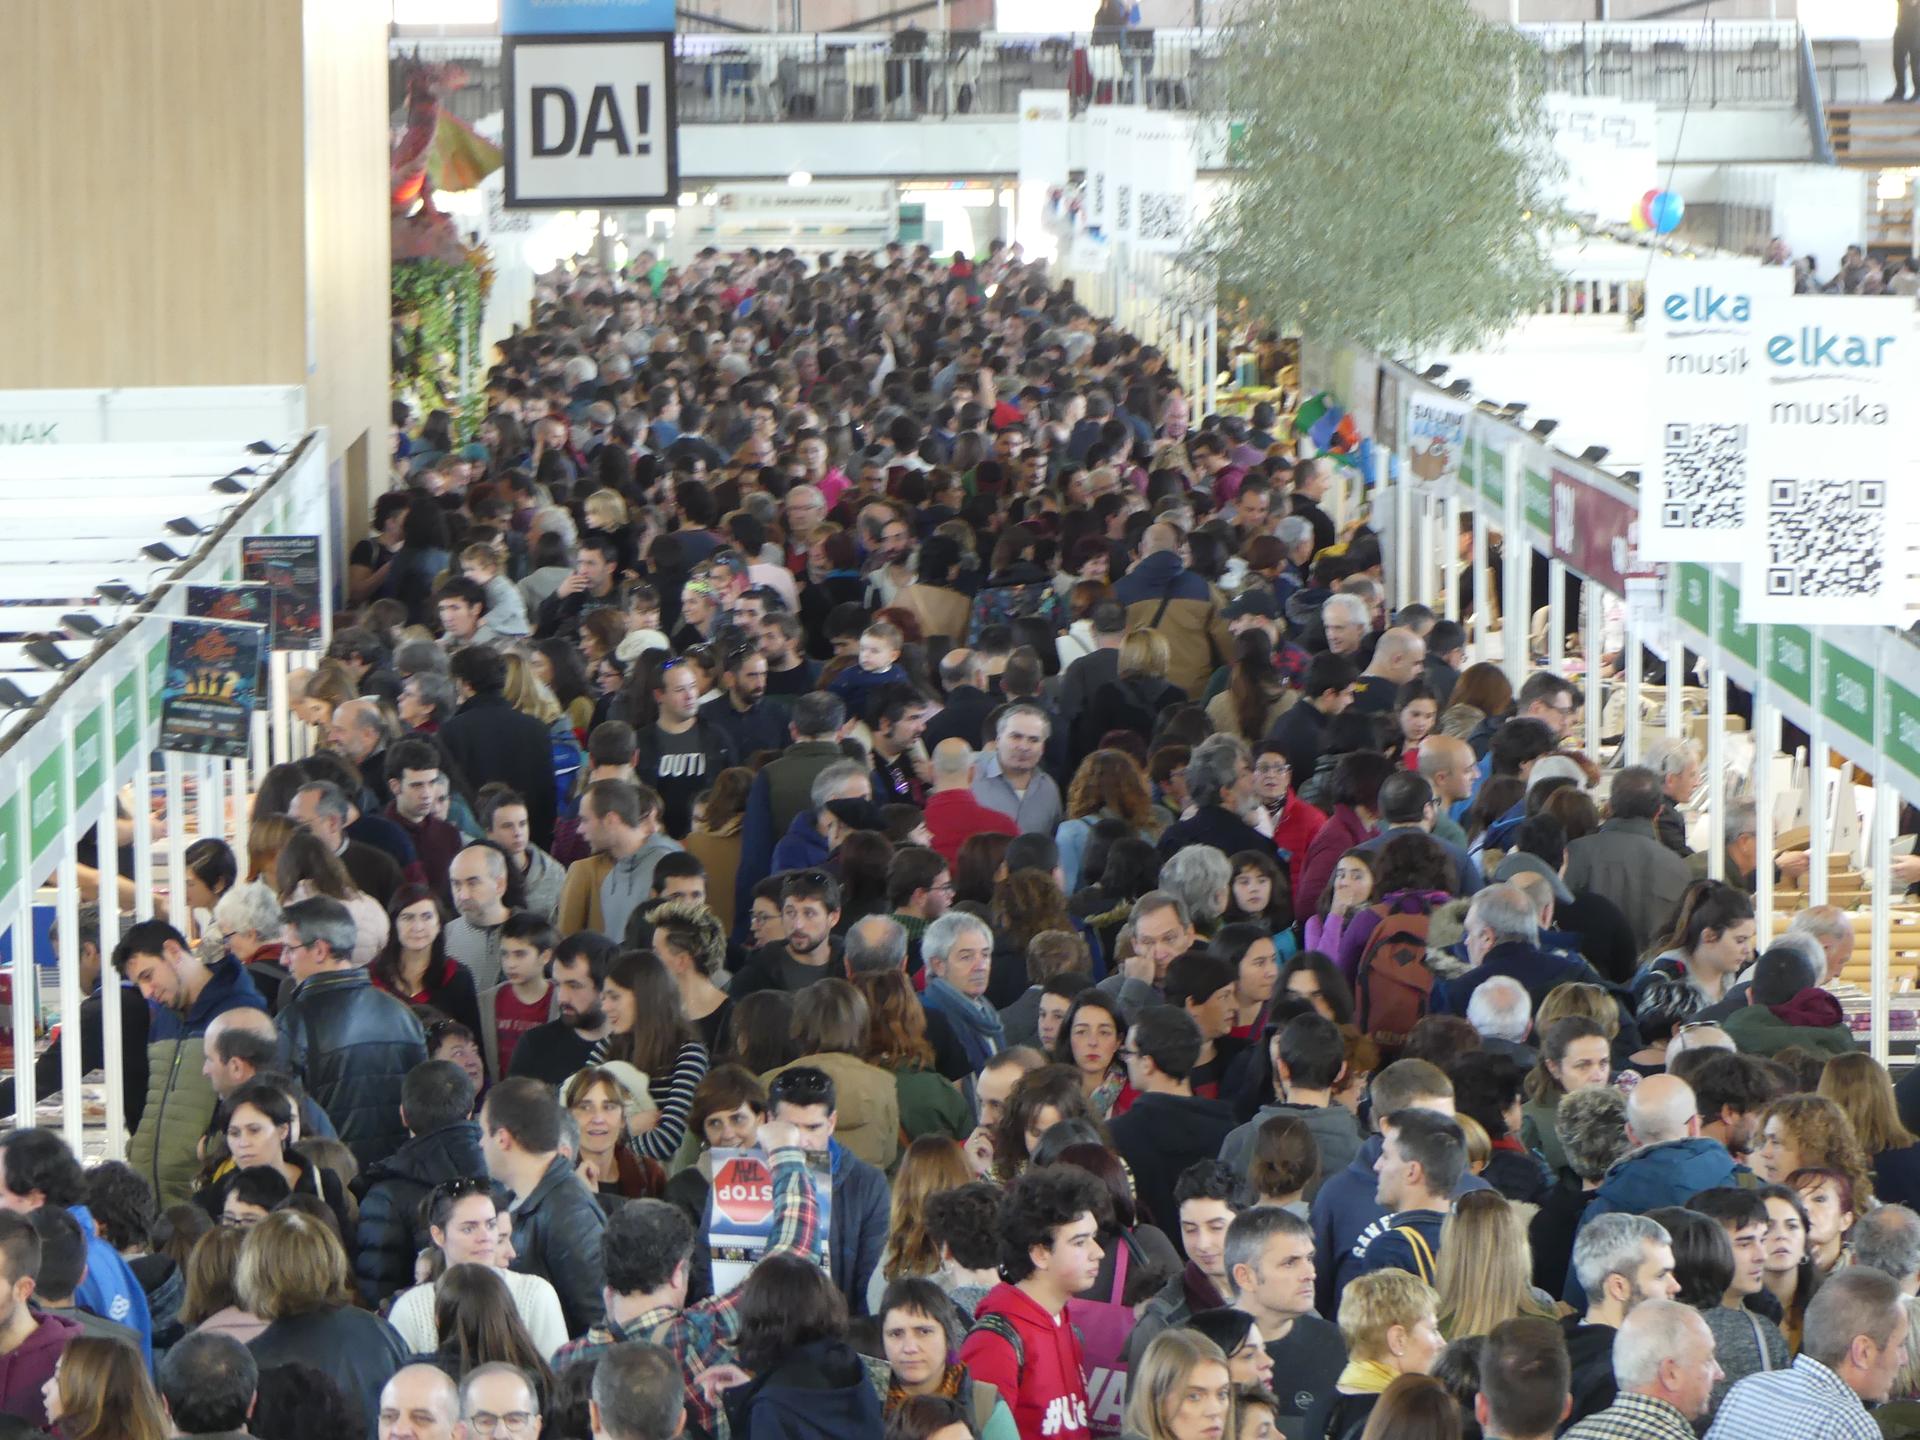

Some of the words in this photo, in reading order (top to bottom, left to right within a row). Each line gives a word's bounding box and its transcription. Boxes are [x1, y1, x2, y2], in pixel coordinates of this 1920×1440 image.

[531, 83, 652, 158] DA!
[1767, 326, 1897, 367] elkar
[1770, 395, 1889, 426] musika
[718, 1186, 773, 1201] STOP
